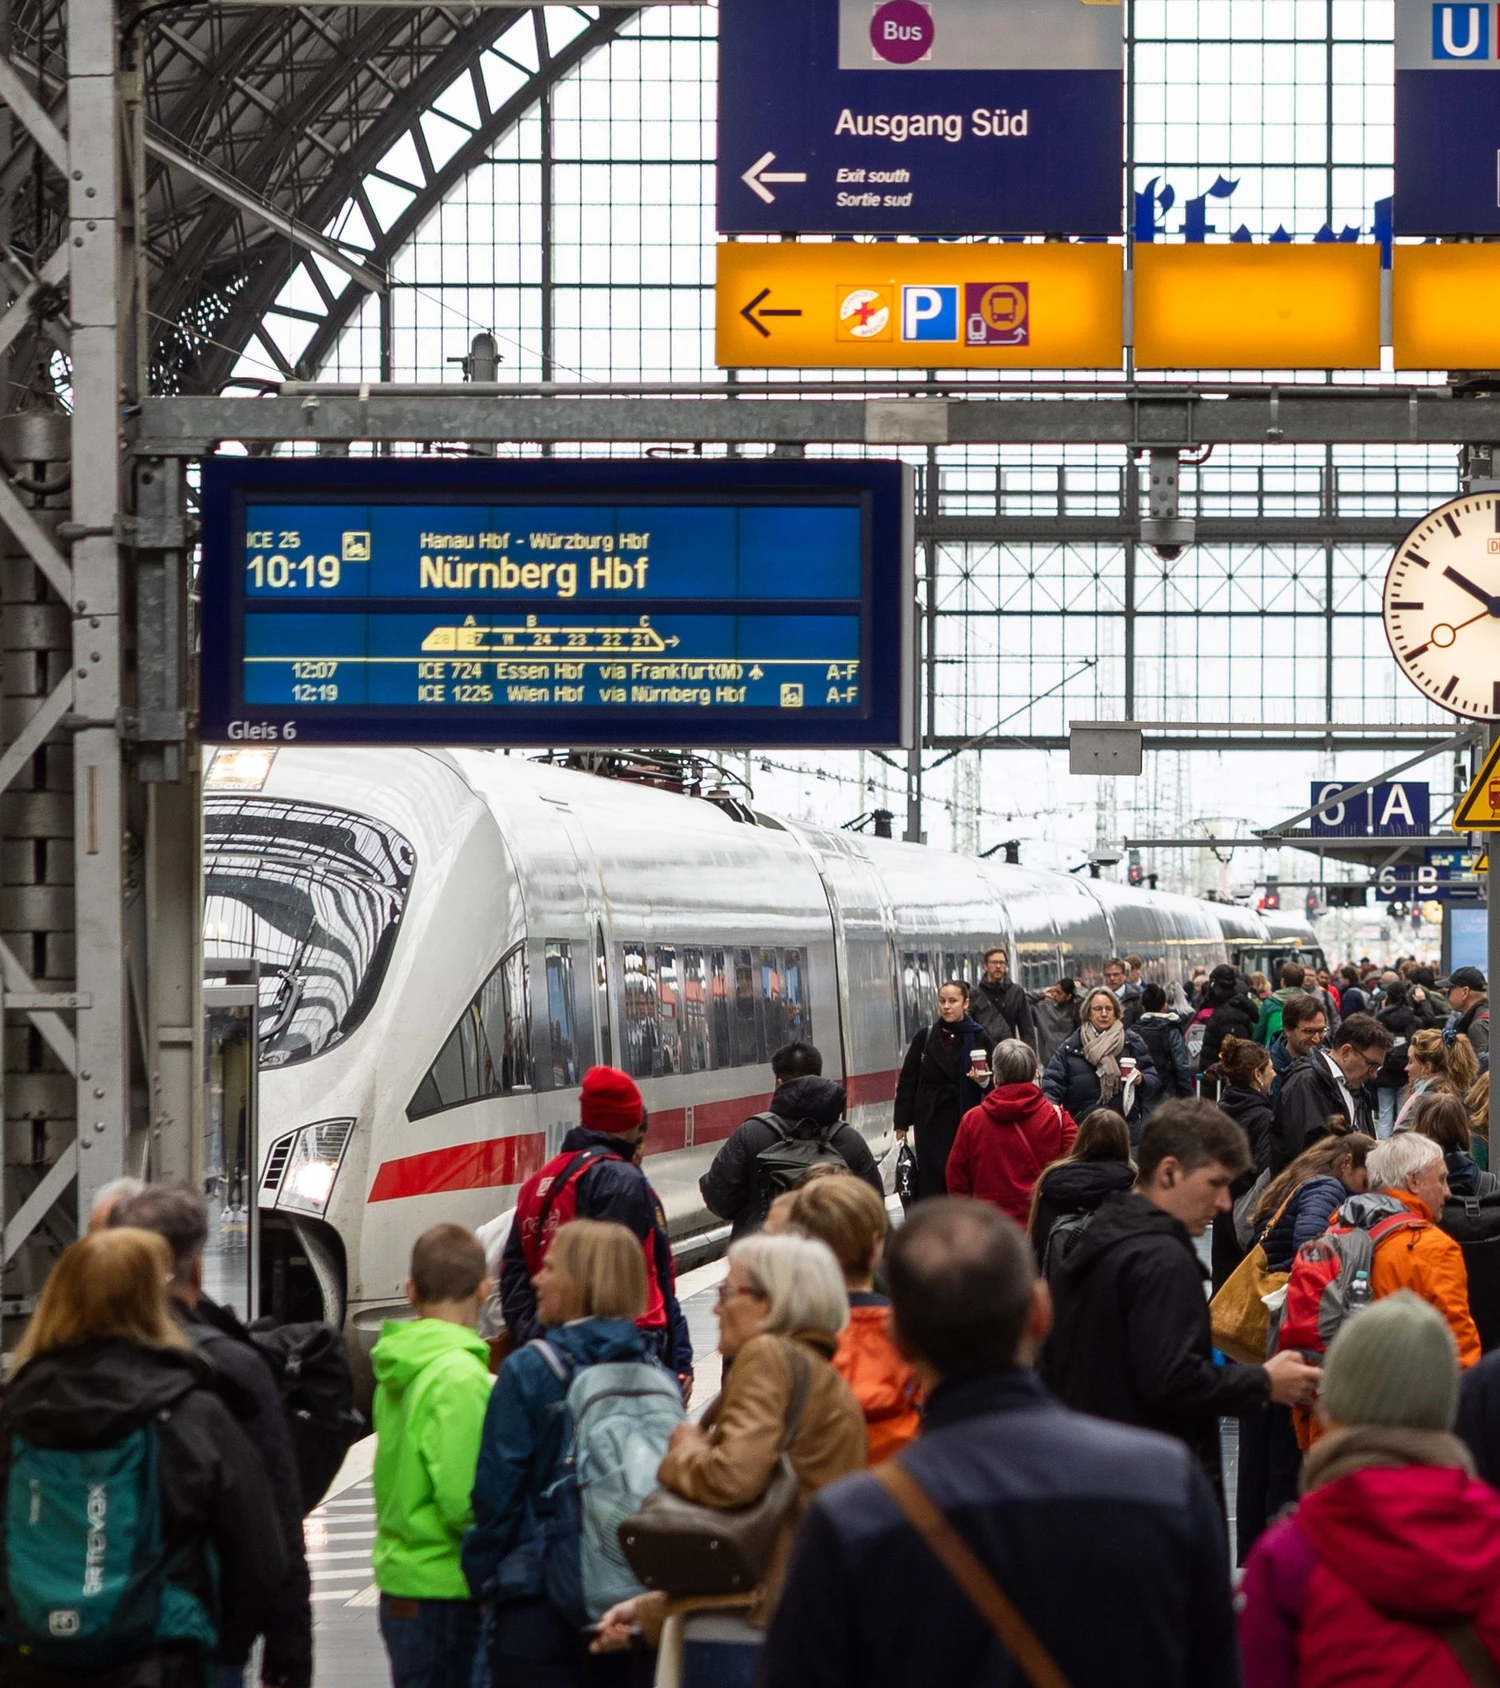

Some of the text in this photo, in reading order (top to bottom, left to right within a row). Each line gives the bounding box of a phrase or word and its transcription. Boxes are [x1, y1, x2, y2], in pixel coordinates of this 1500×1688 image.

[883, 20, 923, 41] Bus
[1442, 6, 1480, 57] U
[834, 108, 1029, 142] Ausgang Süd
[836, 169, 910, 183] Exit south
[836, 192, 913, 207] Sortie sud
[907, 289, 943, 338] P
[246, 532, 301, 548] ICE 25
[420, 533, 475, 549] Hanau
[479, 533, 511, 549] Hbf
[530, 533, 614, 551] Würzburg
[619, 534, 650, 549] Hbf
[246, 555, 341, 588] 10:19
[420, 556, 648, 598] Nürnberg Hbf
[291, 662, 338, 679] 12:07
[418, 663, 743, 682] ICE 724 Essen Hbf via Frankfurt(M)
[826, 665, 858, 681] A-F
[291, 685, 338, 702] 12:19
[418, 685, 747, 706] ICE 1225 Wien Hbf via Nürnberg Hbf
[826, 687, 858, 703] A-F
[227, 721, 297, 740] Gleis 6
[1317, 783, 1346, 826] 6
[1380, 785, 1414, 825] A
[1379, 866, 1397, 895] 6
[1418, 866, 1438, 895] B
